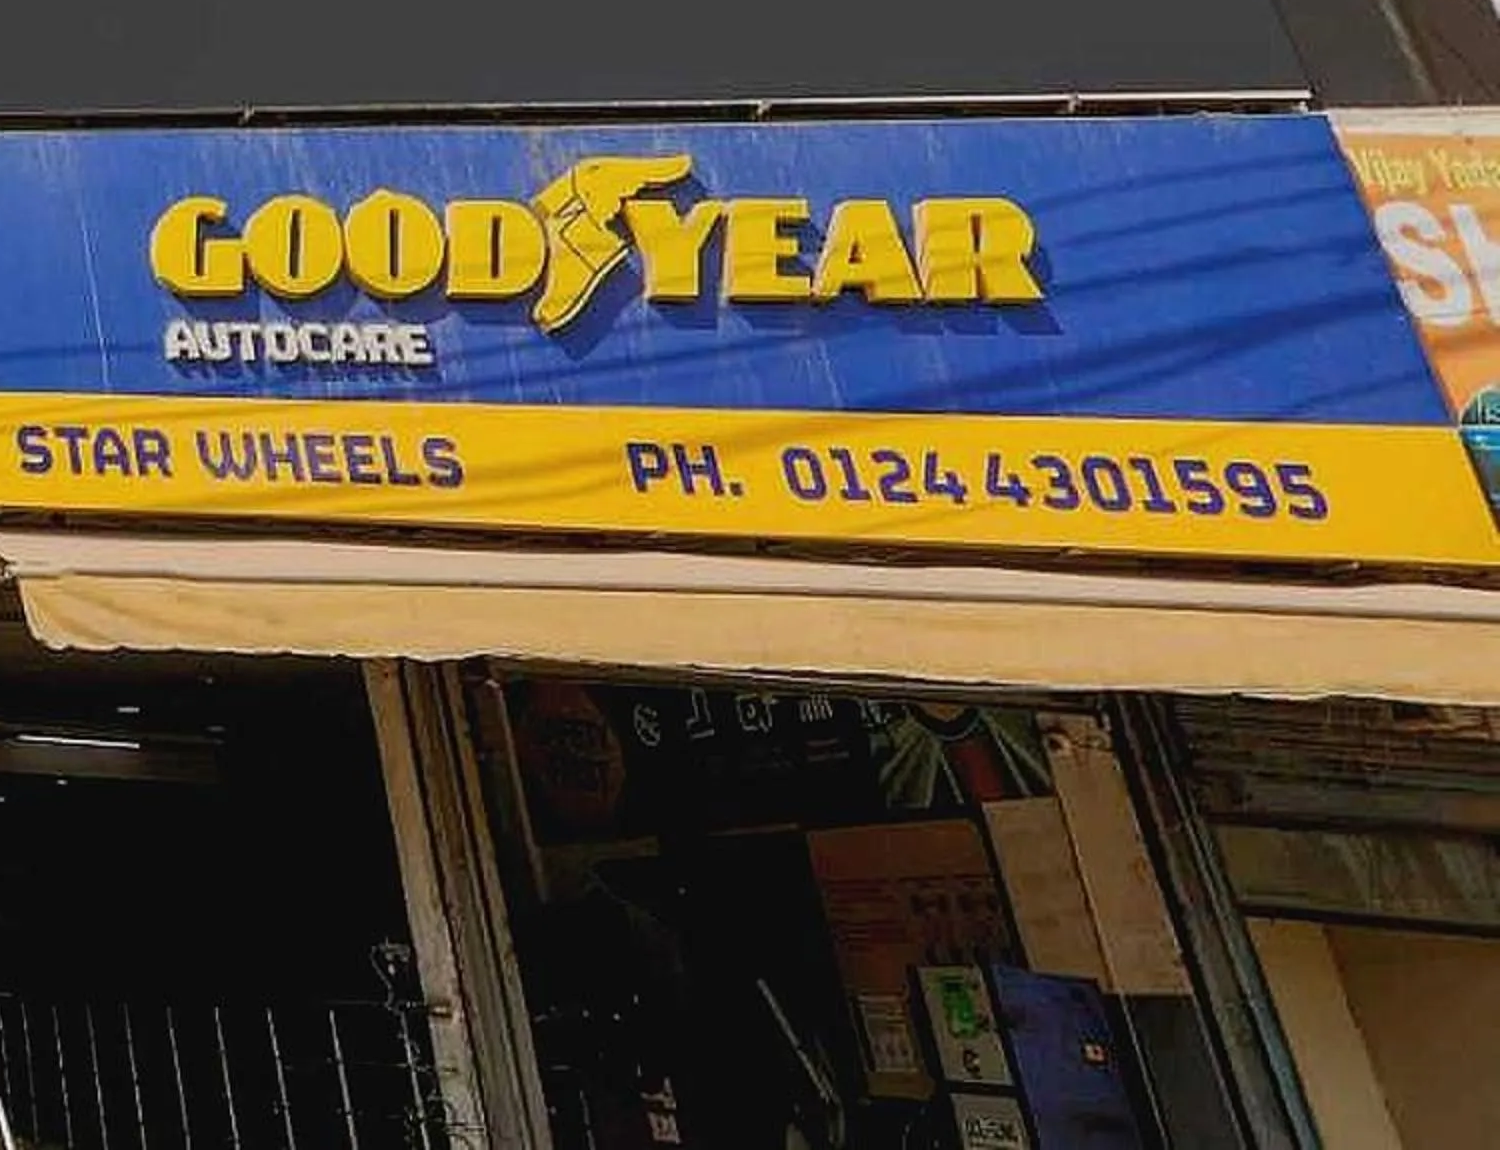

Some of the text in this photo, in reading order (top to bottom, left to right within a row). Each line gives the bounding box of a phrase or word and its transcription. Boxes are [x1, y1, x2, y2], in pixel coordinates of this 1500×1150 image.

[150, 186, 1044, 308] GOODYEAR
[165, 320, 433, 368] AUTOCARE
[17, 425, 1329, 521] STAR WHEELS PH. 0124 4301595
